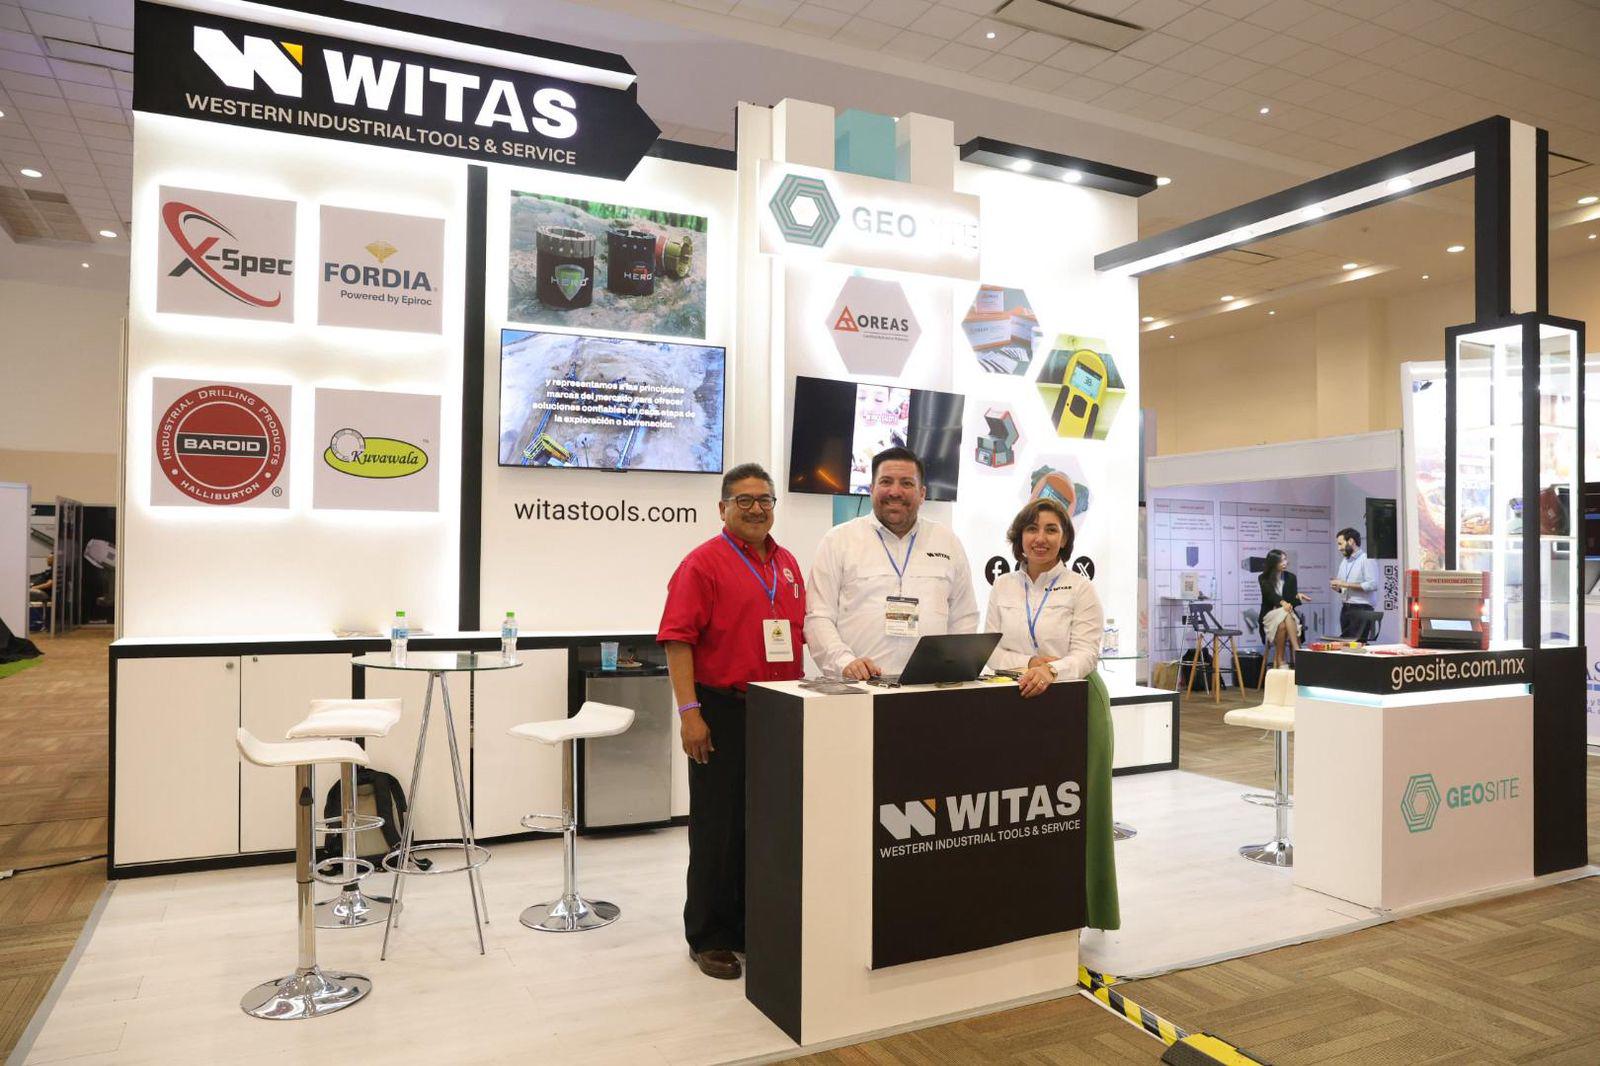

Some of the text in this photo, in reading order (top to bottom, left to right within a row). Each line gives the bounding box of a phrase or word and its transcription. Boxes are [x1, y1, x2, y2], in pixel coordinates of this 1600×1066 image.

[323, 49, 579, 140] WITAS
[185, 93, 577, 165] WESTERN INDUSTRIAL TOOLS & SERVICE
[168, 237, 293, 277] X-Spec
[324, 262, 432, 292] FORDIA
[624, 272, 653, 281] HERO
[340, 289, 432, 306] Powered by Epiroc
[857, 315, 909, 332] OREAS
[553, 379, 617, 391] representamos
[639, 385, 685, 395] principales
[533, 401, 580, 412] soluciones
[582, 404, 626, 415] confiables
[627, 407, 638, 415] en
[547, 391, 684, 406] marcas del mercado para ofrecer
[162, 389, 281, 466] INDUSTRIAL DRILLING PRODUCTS
[554, 414, 563, 424] la
[564, 416, 615, 427] exploración
[184, 438, 261, 452] BAROID
[351, 450, 419, 465] Kuvawala
[180, 480, 260, 500] HALLIBURTON
[514, 498, 697, 523] witastools.com
[1391, 658, 1525, 690] geosite.com.mx
[1446, 777, 1520, 809] GEOSITE
[946, 780, 1081, 832] WITAS
[880, 819, 1081, 859] WESTERN INDUSTRIAL TOOLS & SERVICE
